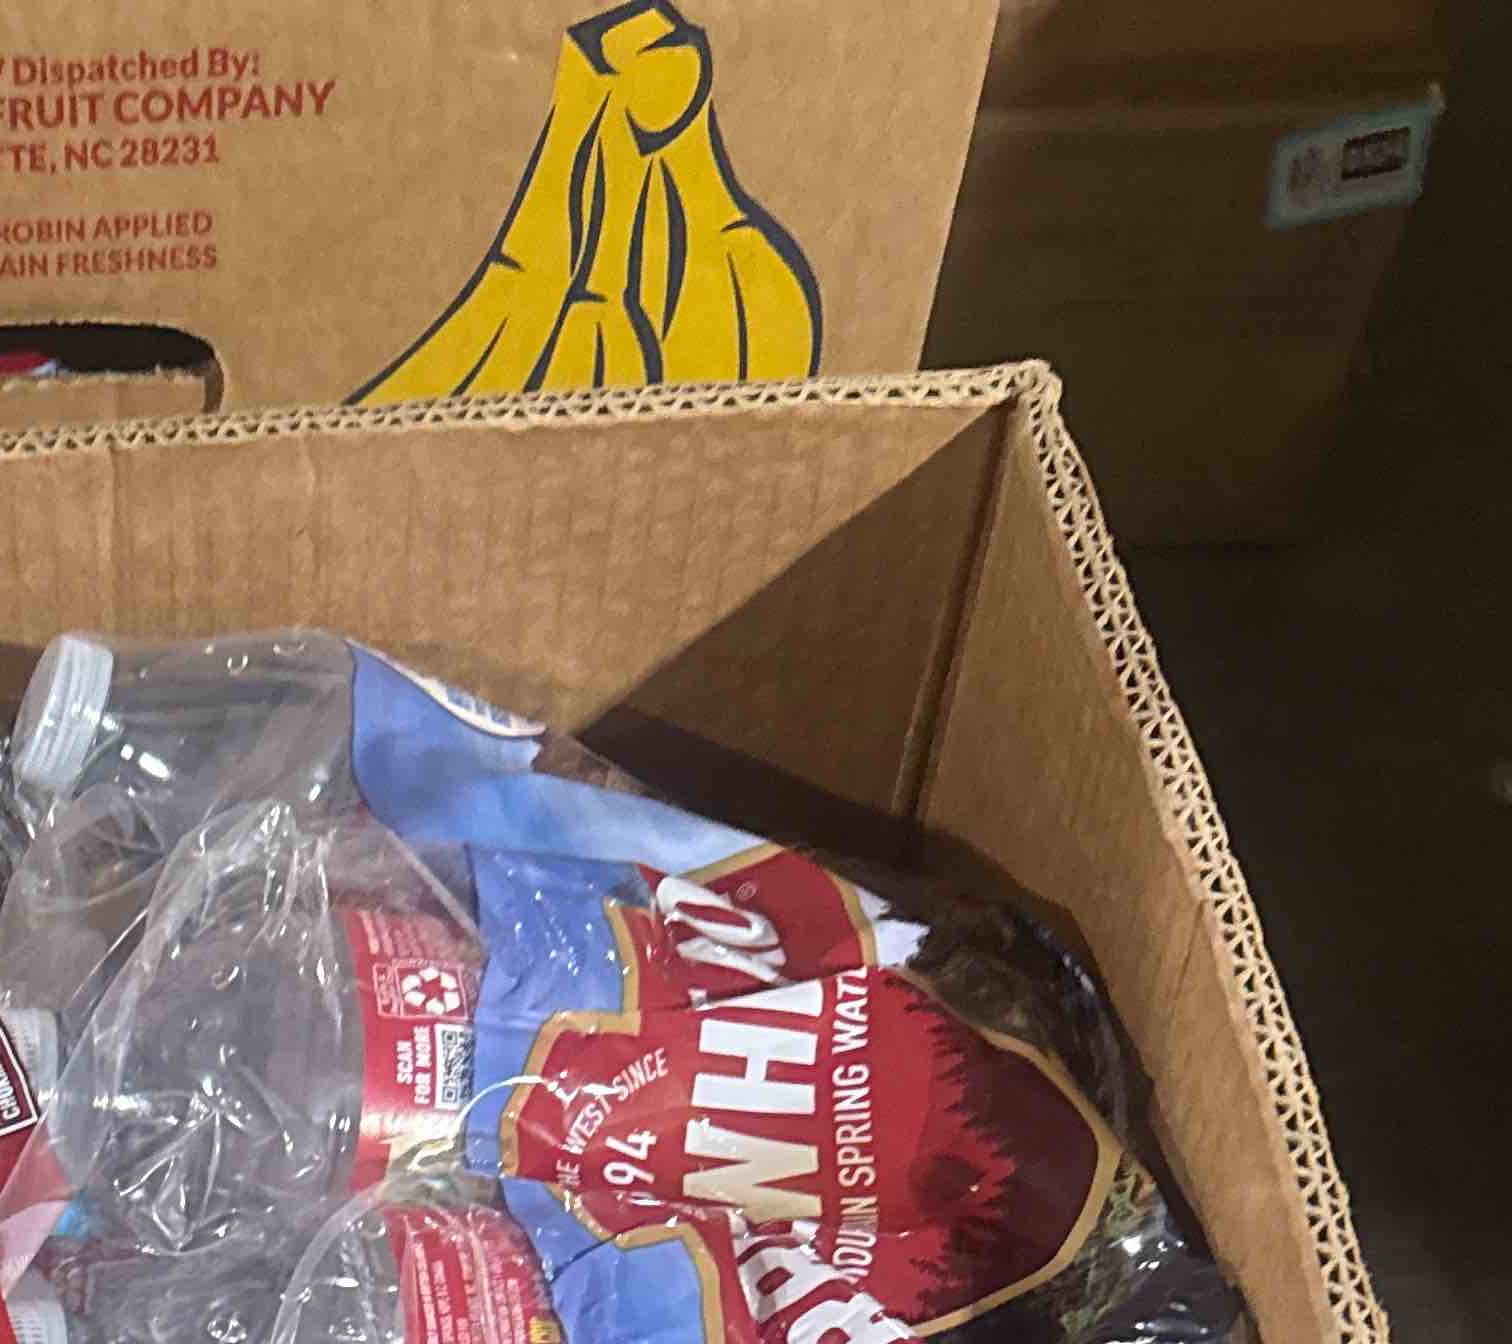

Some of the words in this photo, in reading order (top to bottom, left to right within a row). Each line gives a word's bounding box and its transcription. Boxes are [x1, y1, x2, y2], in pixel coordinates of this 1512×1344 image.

[13, 47, 199, 88] Dispatched
[208, 46, 260, 81] By:
[112, 81, 336, 126] COMPANY
[64, 140, 114, 171] NC
[119, 135, 219, 169] 28231
[93, 211, 213, 239] APPLIED
[56, 245, 217, 274] FRESHNESS
[396, 1040, 413, 1085] SCAN
[414, 1026, 431, 1070] MORE
[414, 1071, 431, 1105] FOR
[833, 1064, 877, 1188] SPRING
